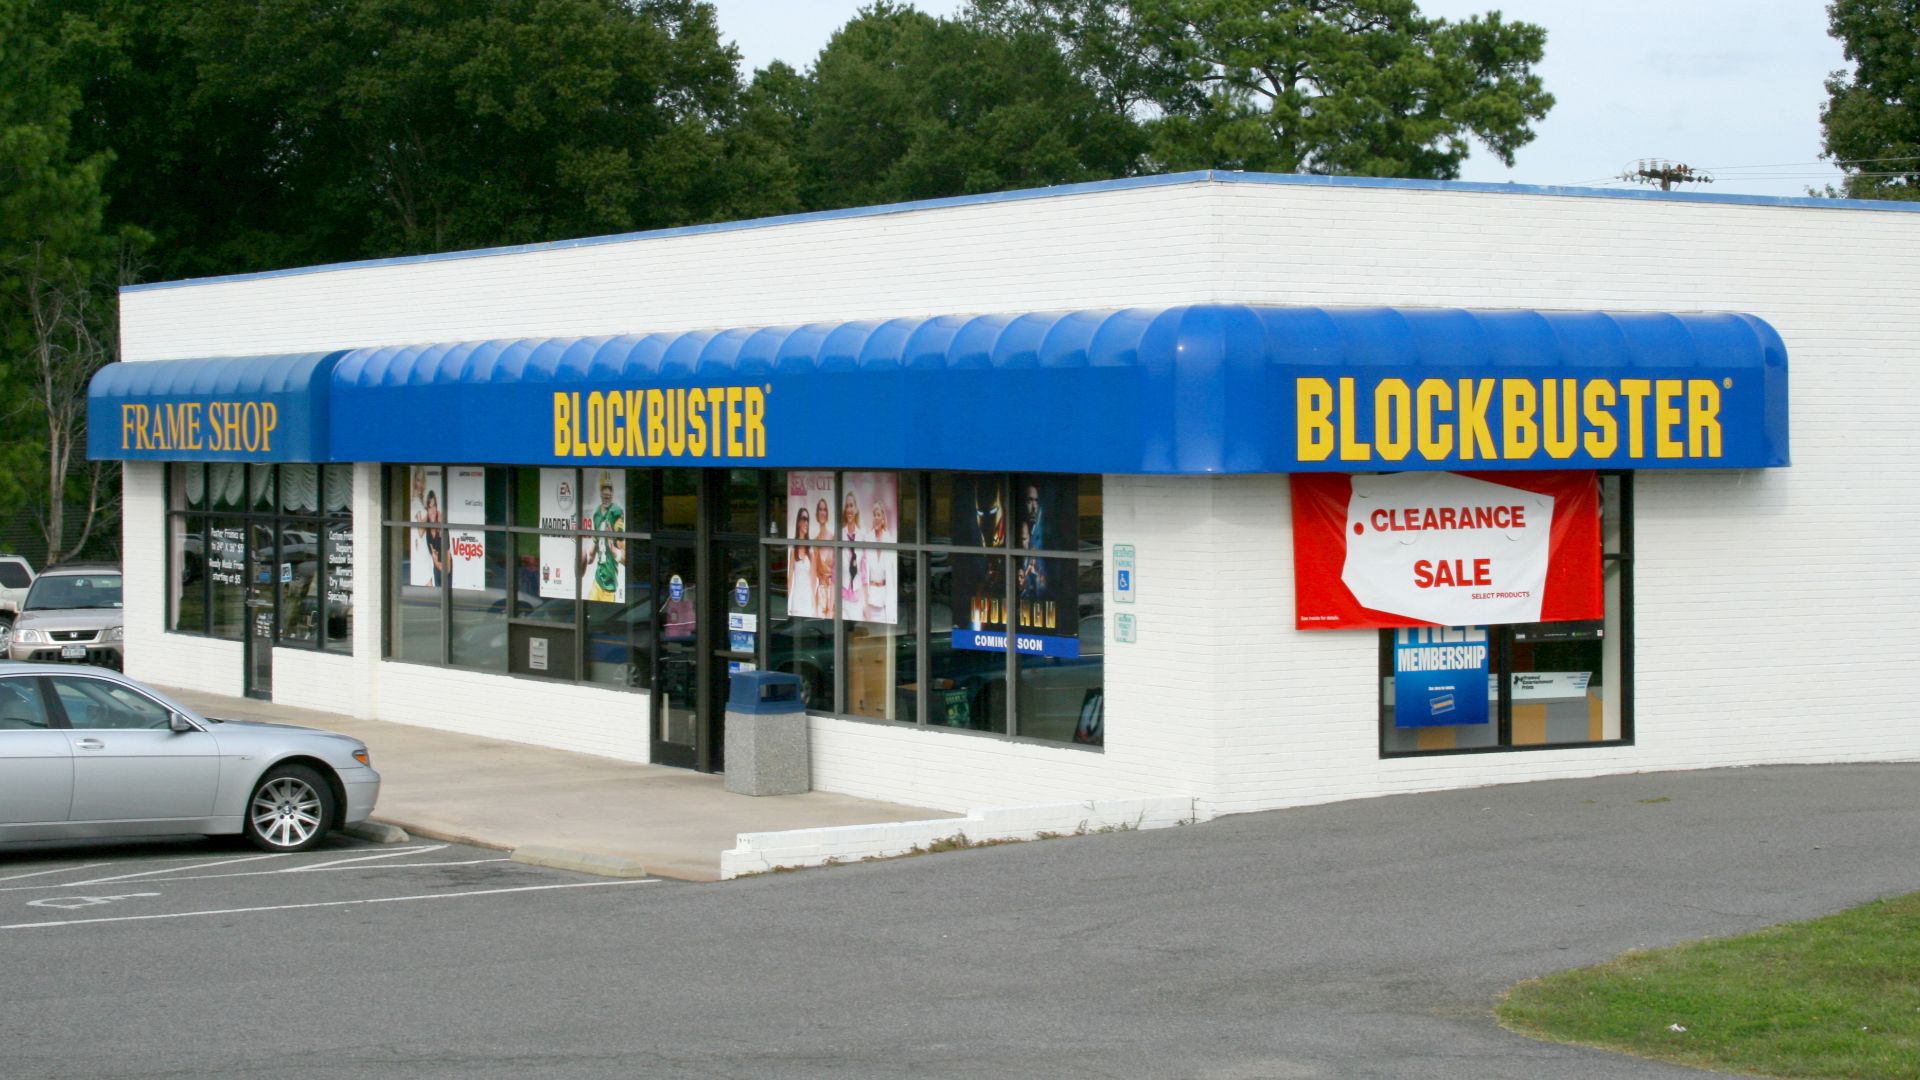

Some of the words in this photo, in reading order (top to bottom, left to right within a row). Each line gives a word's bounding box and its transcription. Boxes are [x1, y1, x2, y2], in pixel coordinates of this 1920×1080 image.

[121, 402, 203, 449] FRAME
[208, 401, 278, 452] SHOP
[541, 517, 570, 538] MADDEN
[1370, 505, 1526, 532] CLEARANCE
[1414, 558, 1492, 589] SALE
[1496, 591, 1530, 600] PRODUCTS
[1017, 637, 1043, 651] SOON
[1397, 645, 1487, 672] MEMBERSHIP
